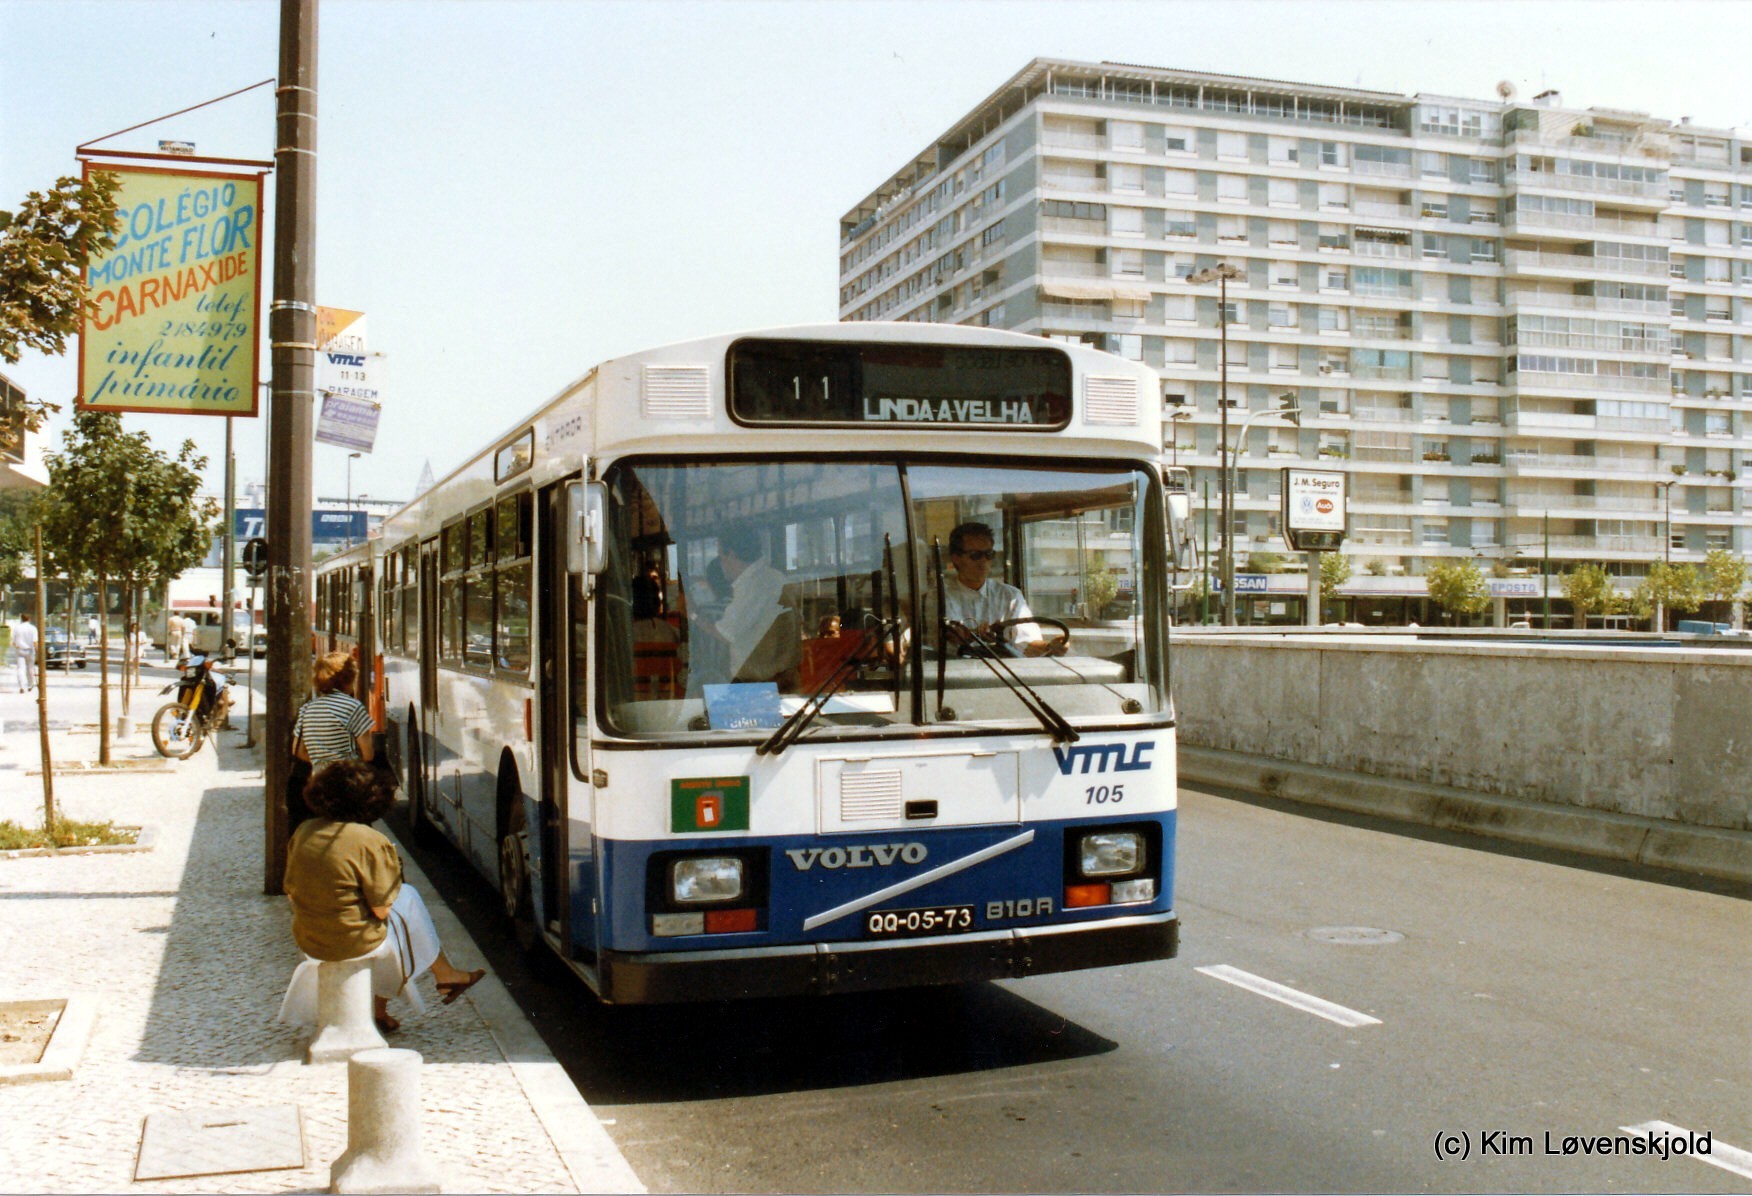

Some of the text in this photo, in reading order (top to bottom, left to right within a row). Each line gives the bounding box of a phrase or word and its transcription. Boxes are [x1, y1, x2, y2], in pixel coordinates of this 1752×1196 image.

[106, 183, 236, 249] COLÉGIO
[89, 204, 254, 286] MONTE FLOR
[93, 252, 248, 331] CARNAXIDE
[107, 338, 239, 378] infantil
[89, 369, 240, 404] primário
[1312, 478, 1340, 489] Seguro
[1085, 784, 1125, 805] 105
[785, 842, 929, 872] VOLVO
[868, 908, 972, 933] QQ-05-73
